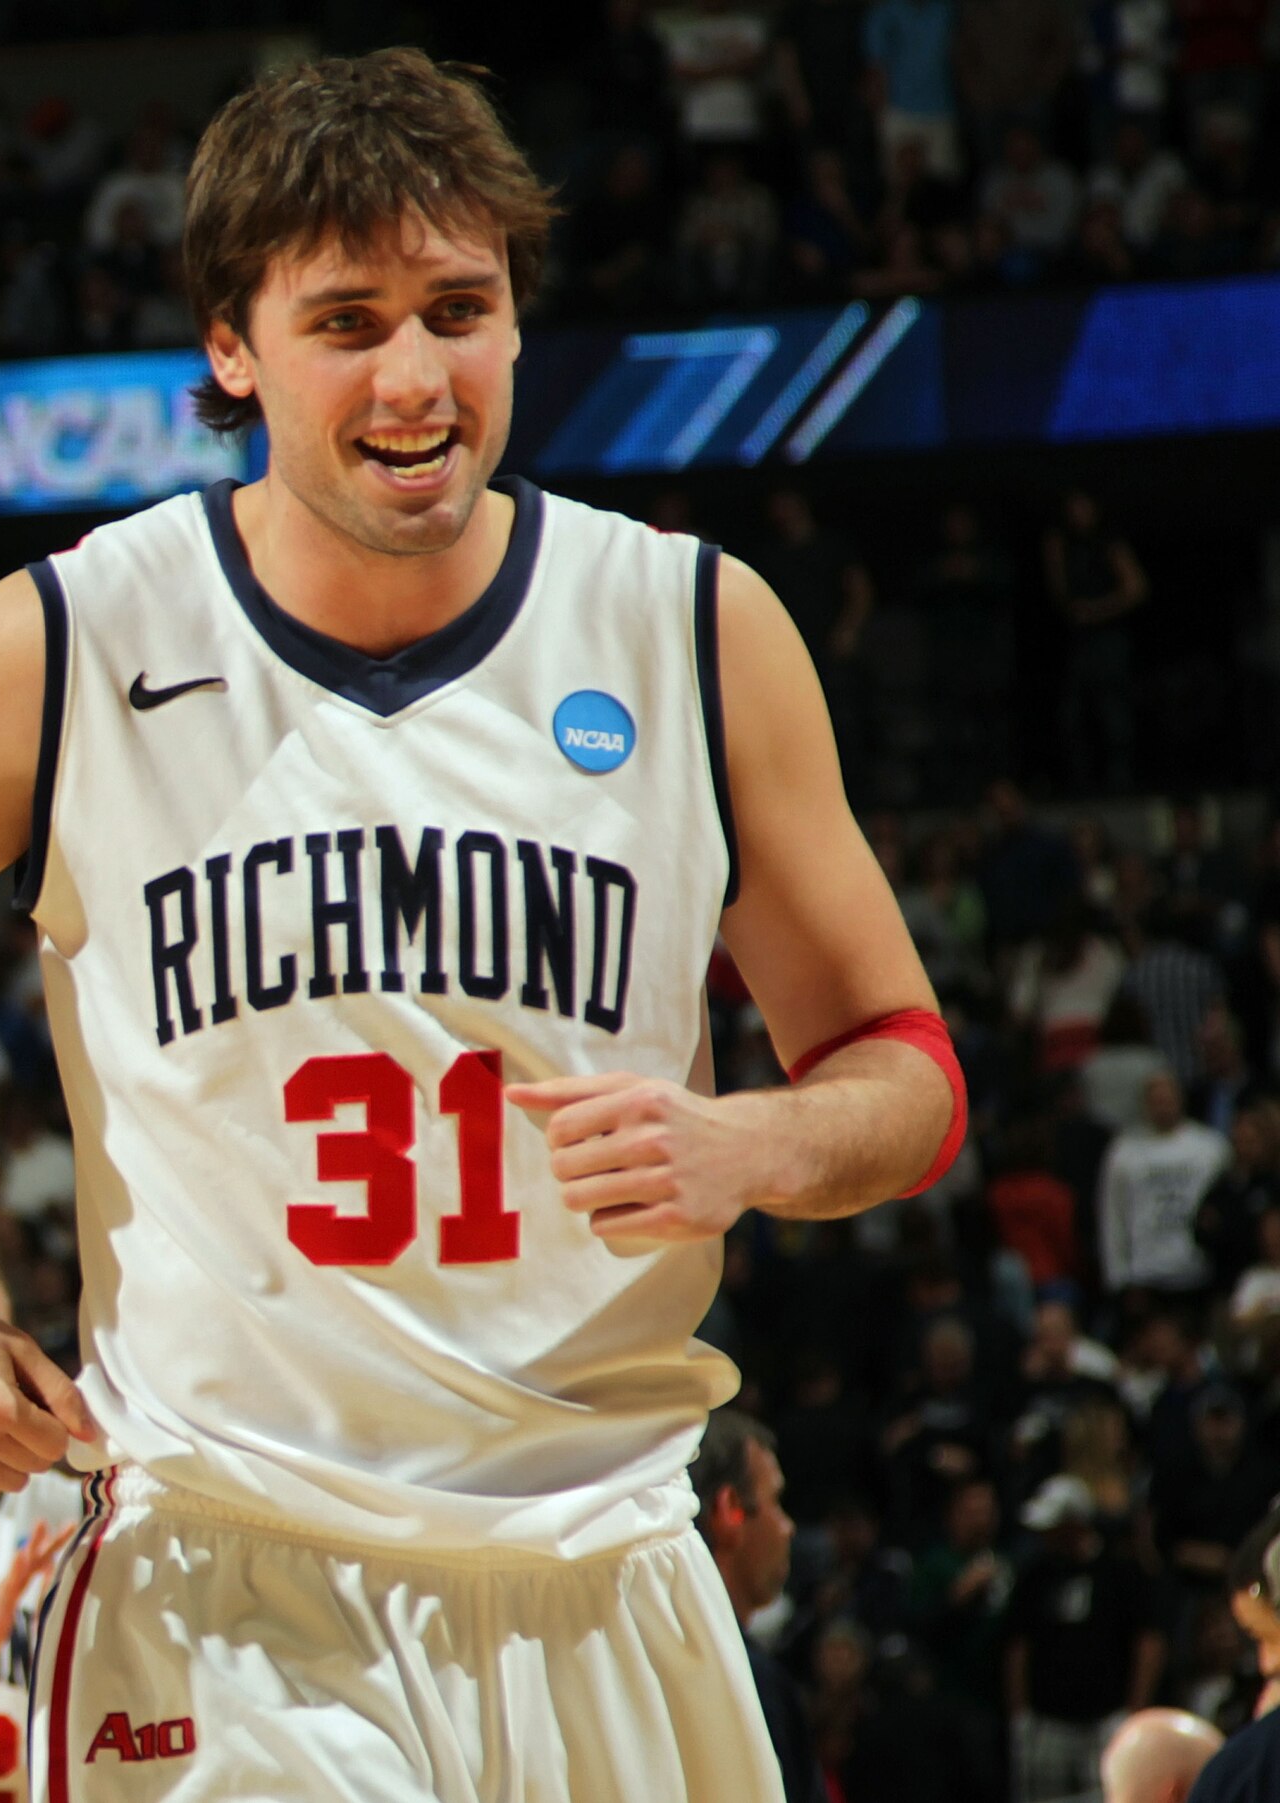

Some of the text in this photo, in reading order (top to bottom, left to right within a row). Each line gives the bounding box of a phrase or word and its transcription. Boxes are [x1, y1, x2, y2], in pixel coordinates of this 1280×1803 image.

[565, 727, 624, 753] NCAA
[143, 824, 638, 1047] RICHMOND
[283, 1049, 520, 1266] 31
[84, 1711, 197, 1764] A10
